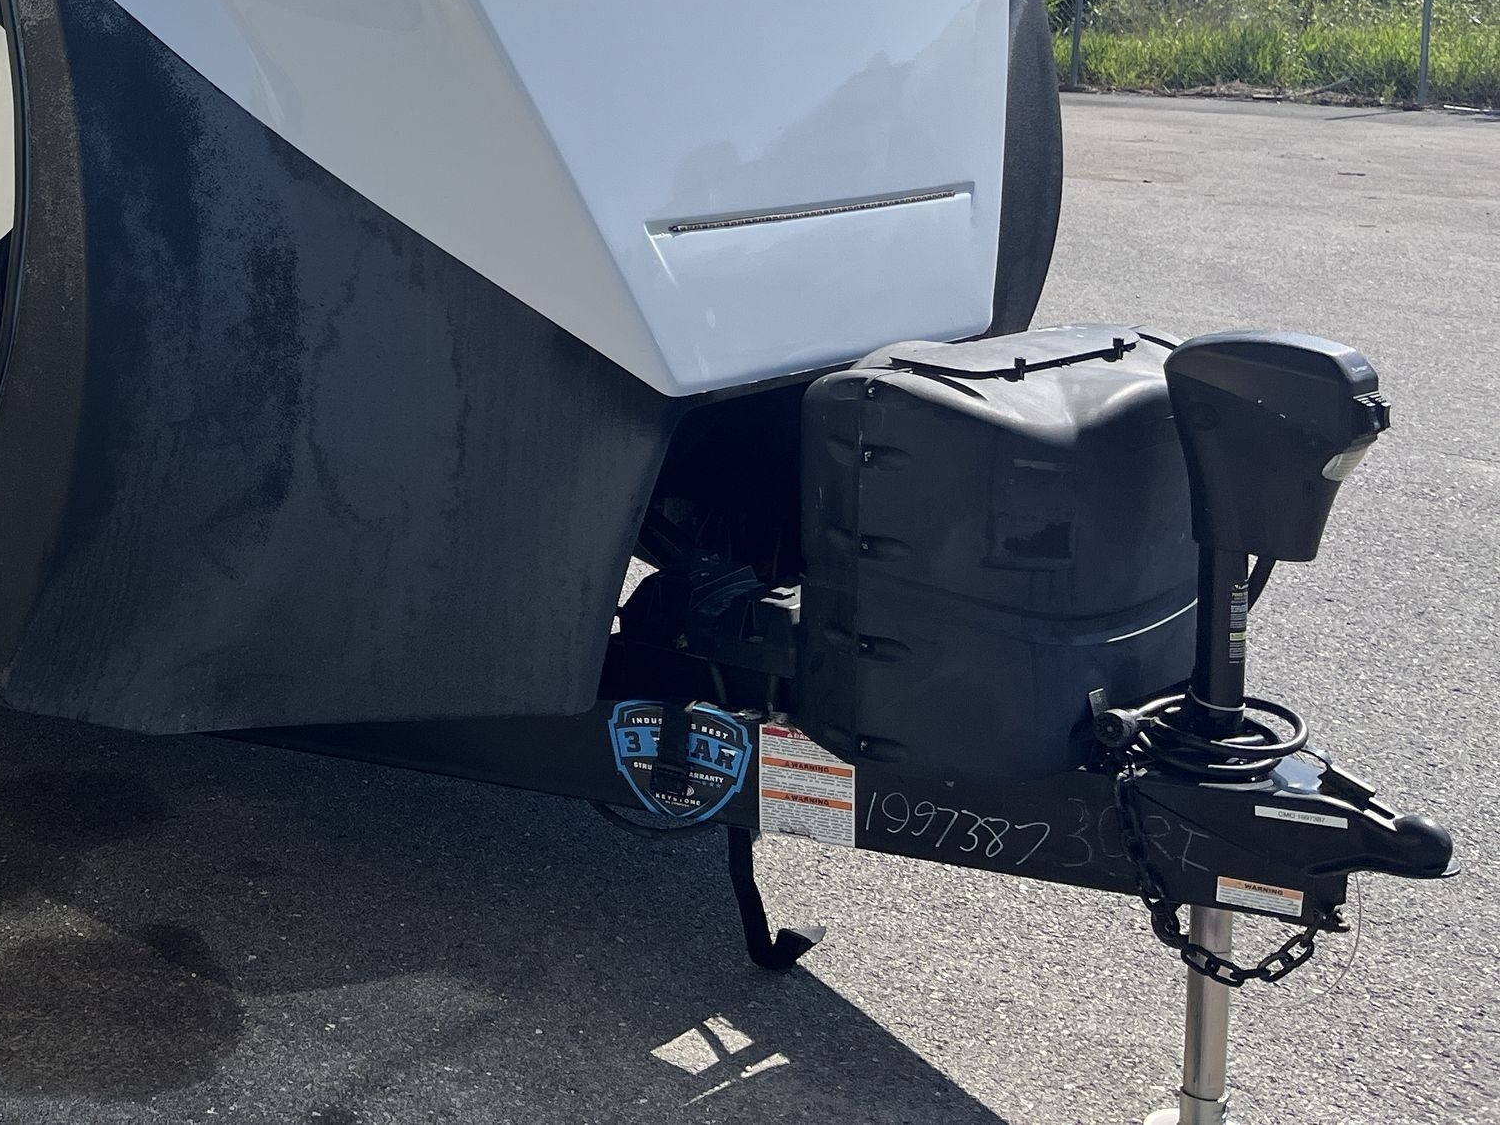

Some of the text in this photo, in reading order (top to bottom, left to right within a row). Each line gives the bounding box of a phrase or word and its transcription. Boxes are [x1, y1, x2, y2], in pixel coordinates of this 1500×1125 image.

[701, 726, 729, 739] BEST
[624, 731, 641, 752] 3
[791, 761, 830, 773] WARNING
[688, 771, 724, 783] ARRANTY
[791, 795, 830, 806] WARNING
[866, 792, 1050, 866] 1997387
[1244, 883, 1284, 896] WARNING
